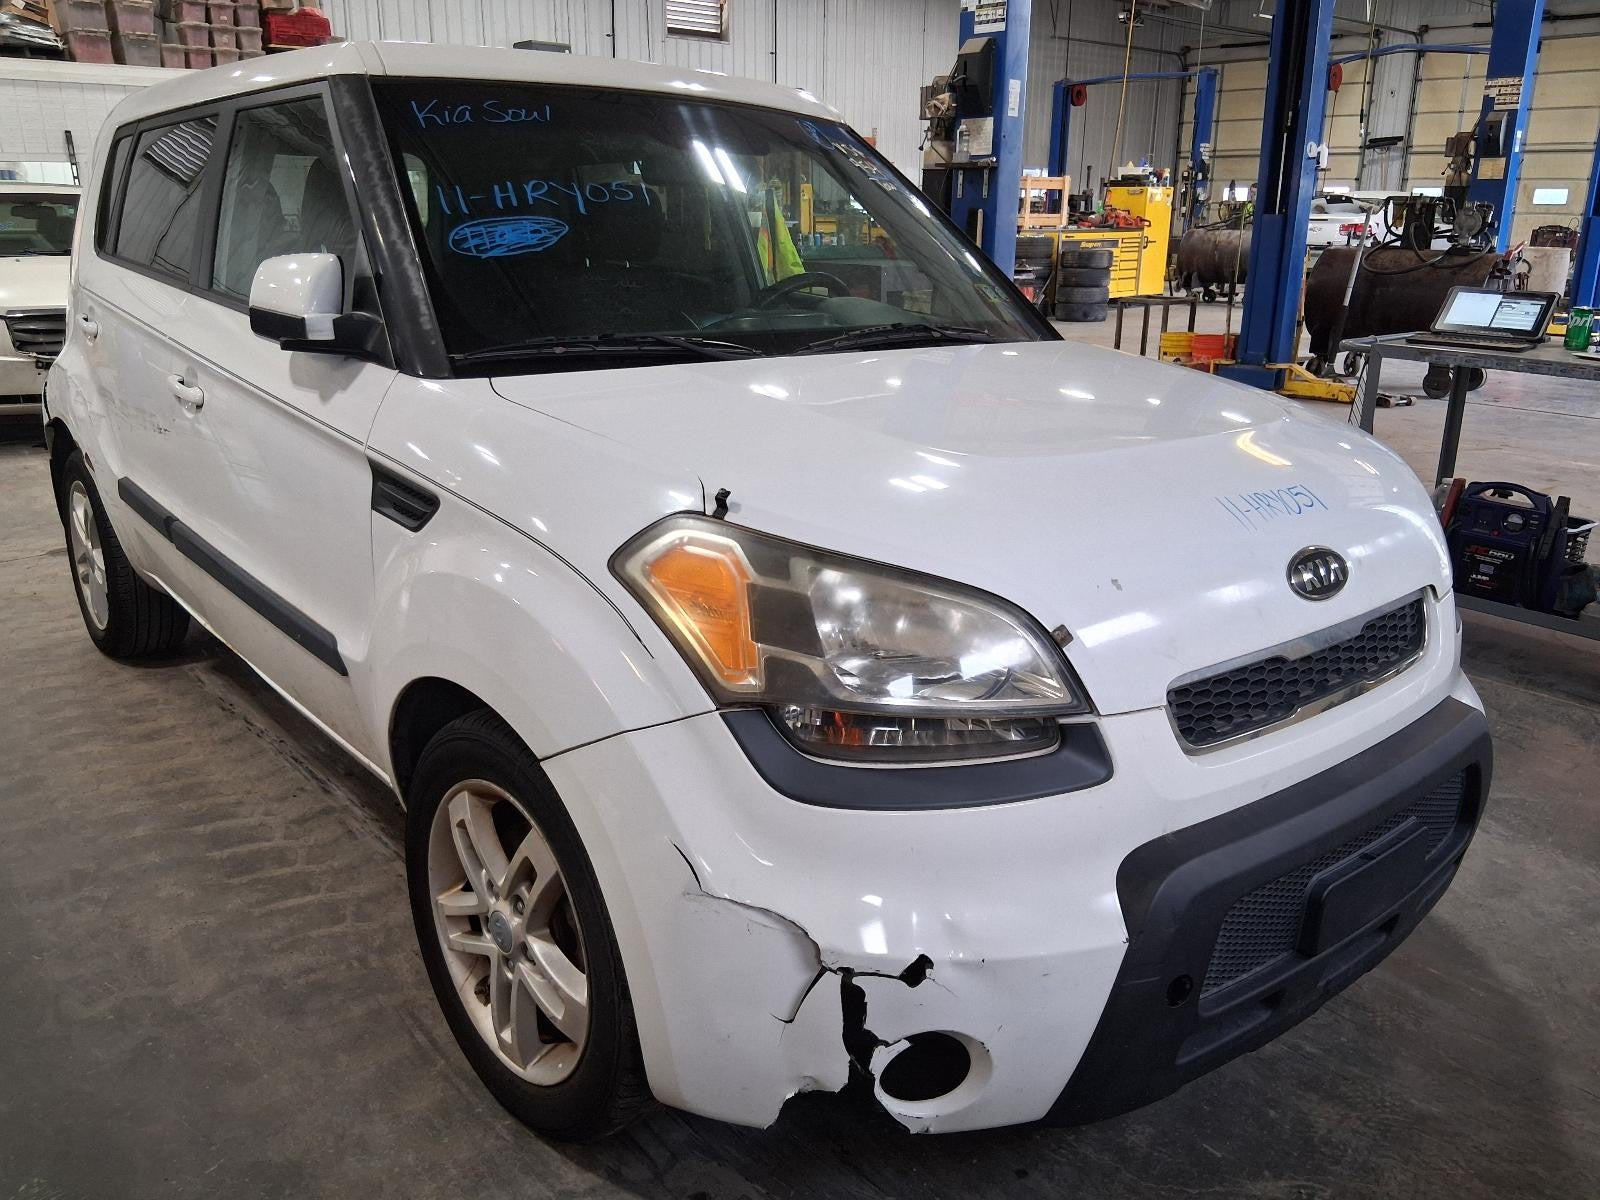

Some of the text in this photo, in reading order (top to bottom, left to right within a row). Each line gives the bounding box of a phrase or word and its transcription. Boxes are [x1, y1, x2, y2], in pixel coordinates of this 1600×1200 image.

[410, 99, 551, 128] Kia Soul
[437, 180, 651, 215] 11-HRY051
[1298, 555, 1345, 591] KIA
